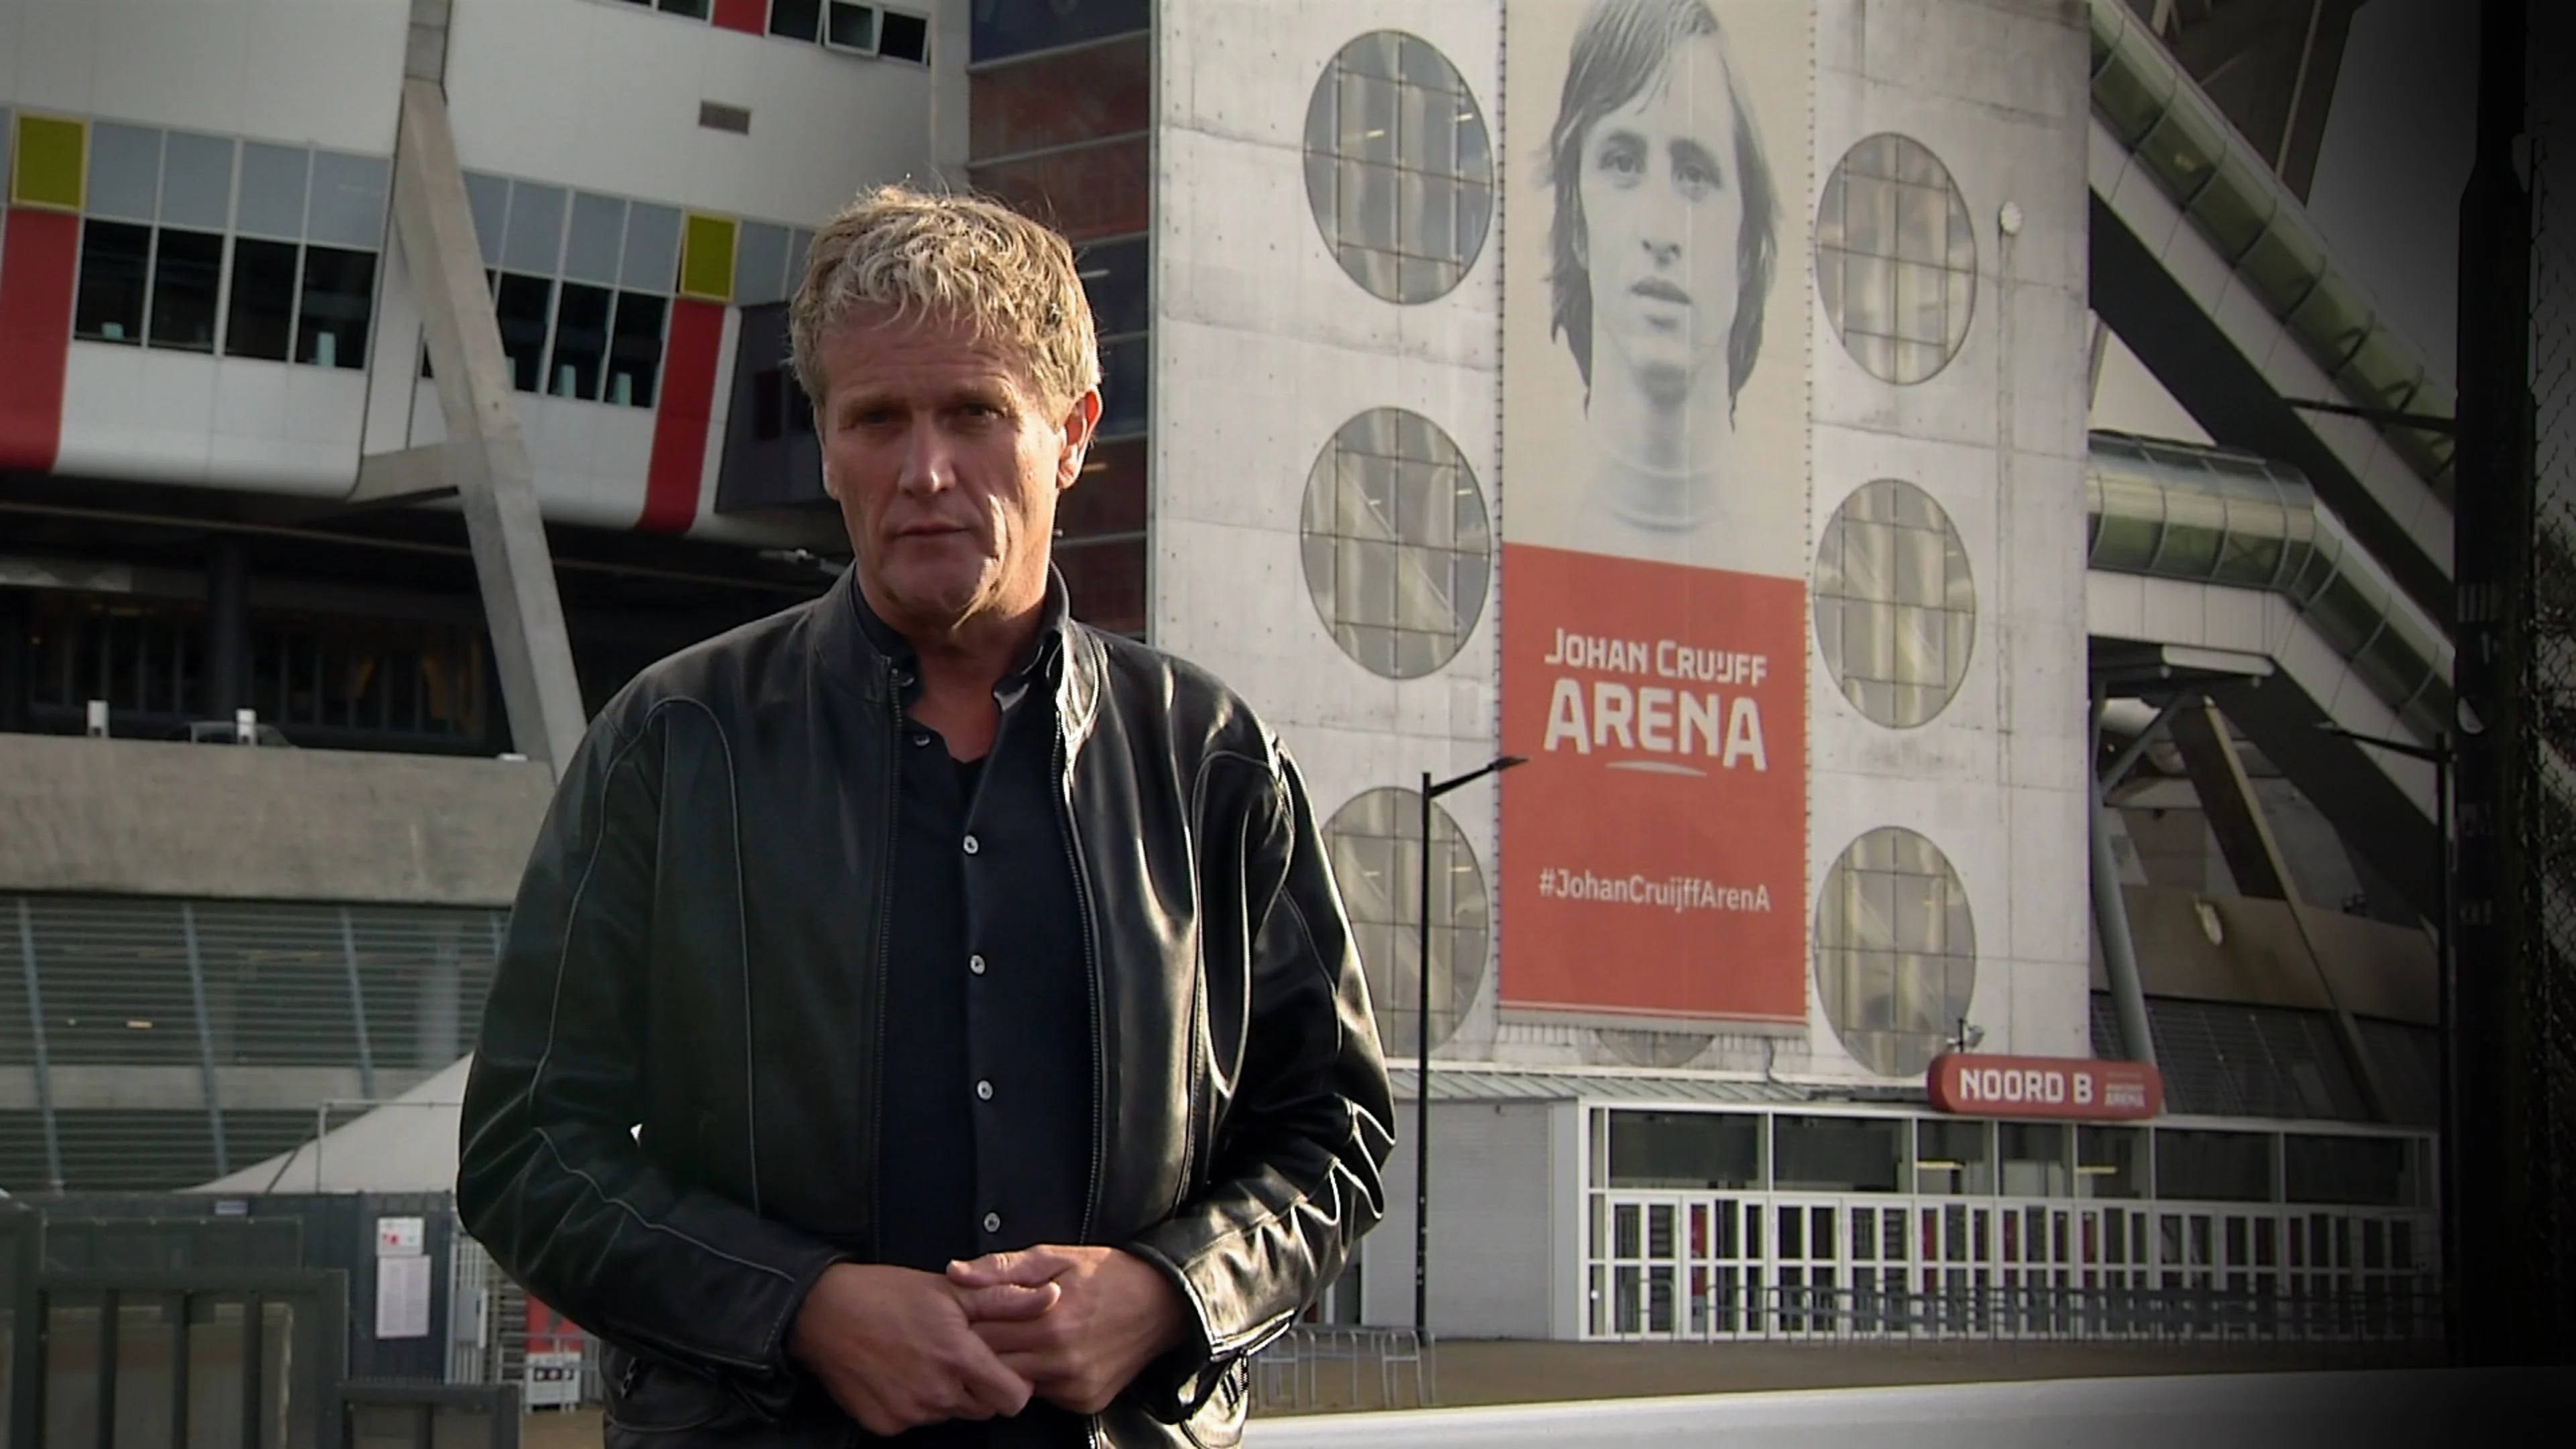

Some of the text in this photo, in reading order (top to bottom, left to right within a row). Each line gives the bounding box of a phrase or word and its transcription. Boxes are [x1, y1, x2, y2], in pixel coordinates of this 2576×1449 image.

[1545, 627, 1648, 674] JOHAN
[1544, 678, 1768, 771] ARENA
[1539, 868, 1770, 913] #JohanCruijffArenA
[1960, 1068, 2092, 1104] NOORD B
